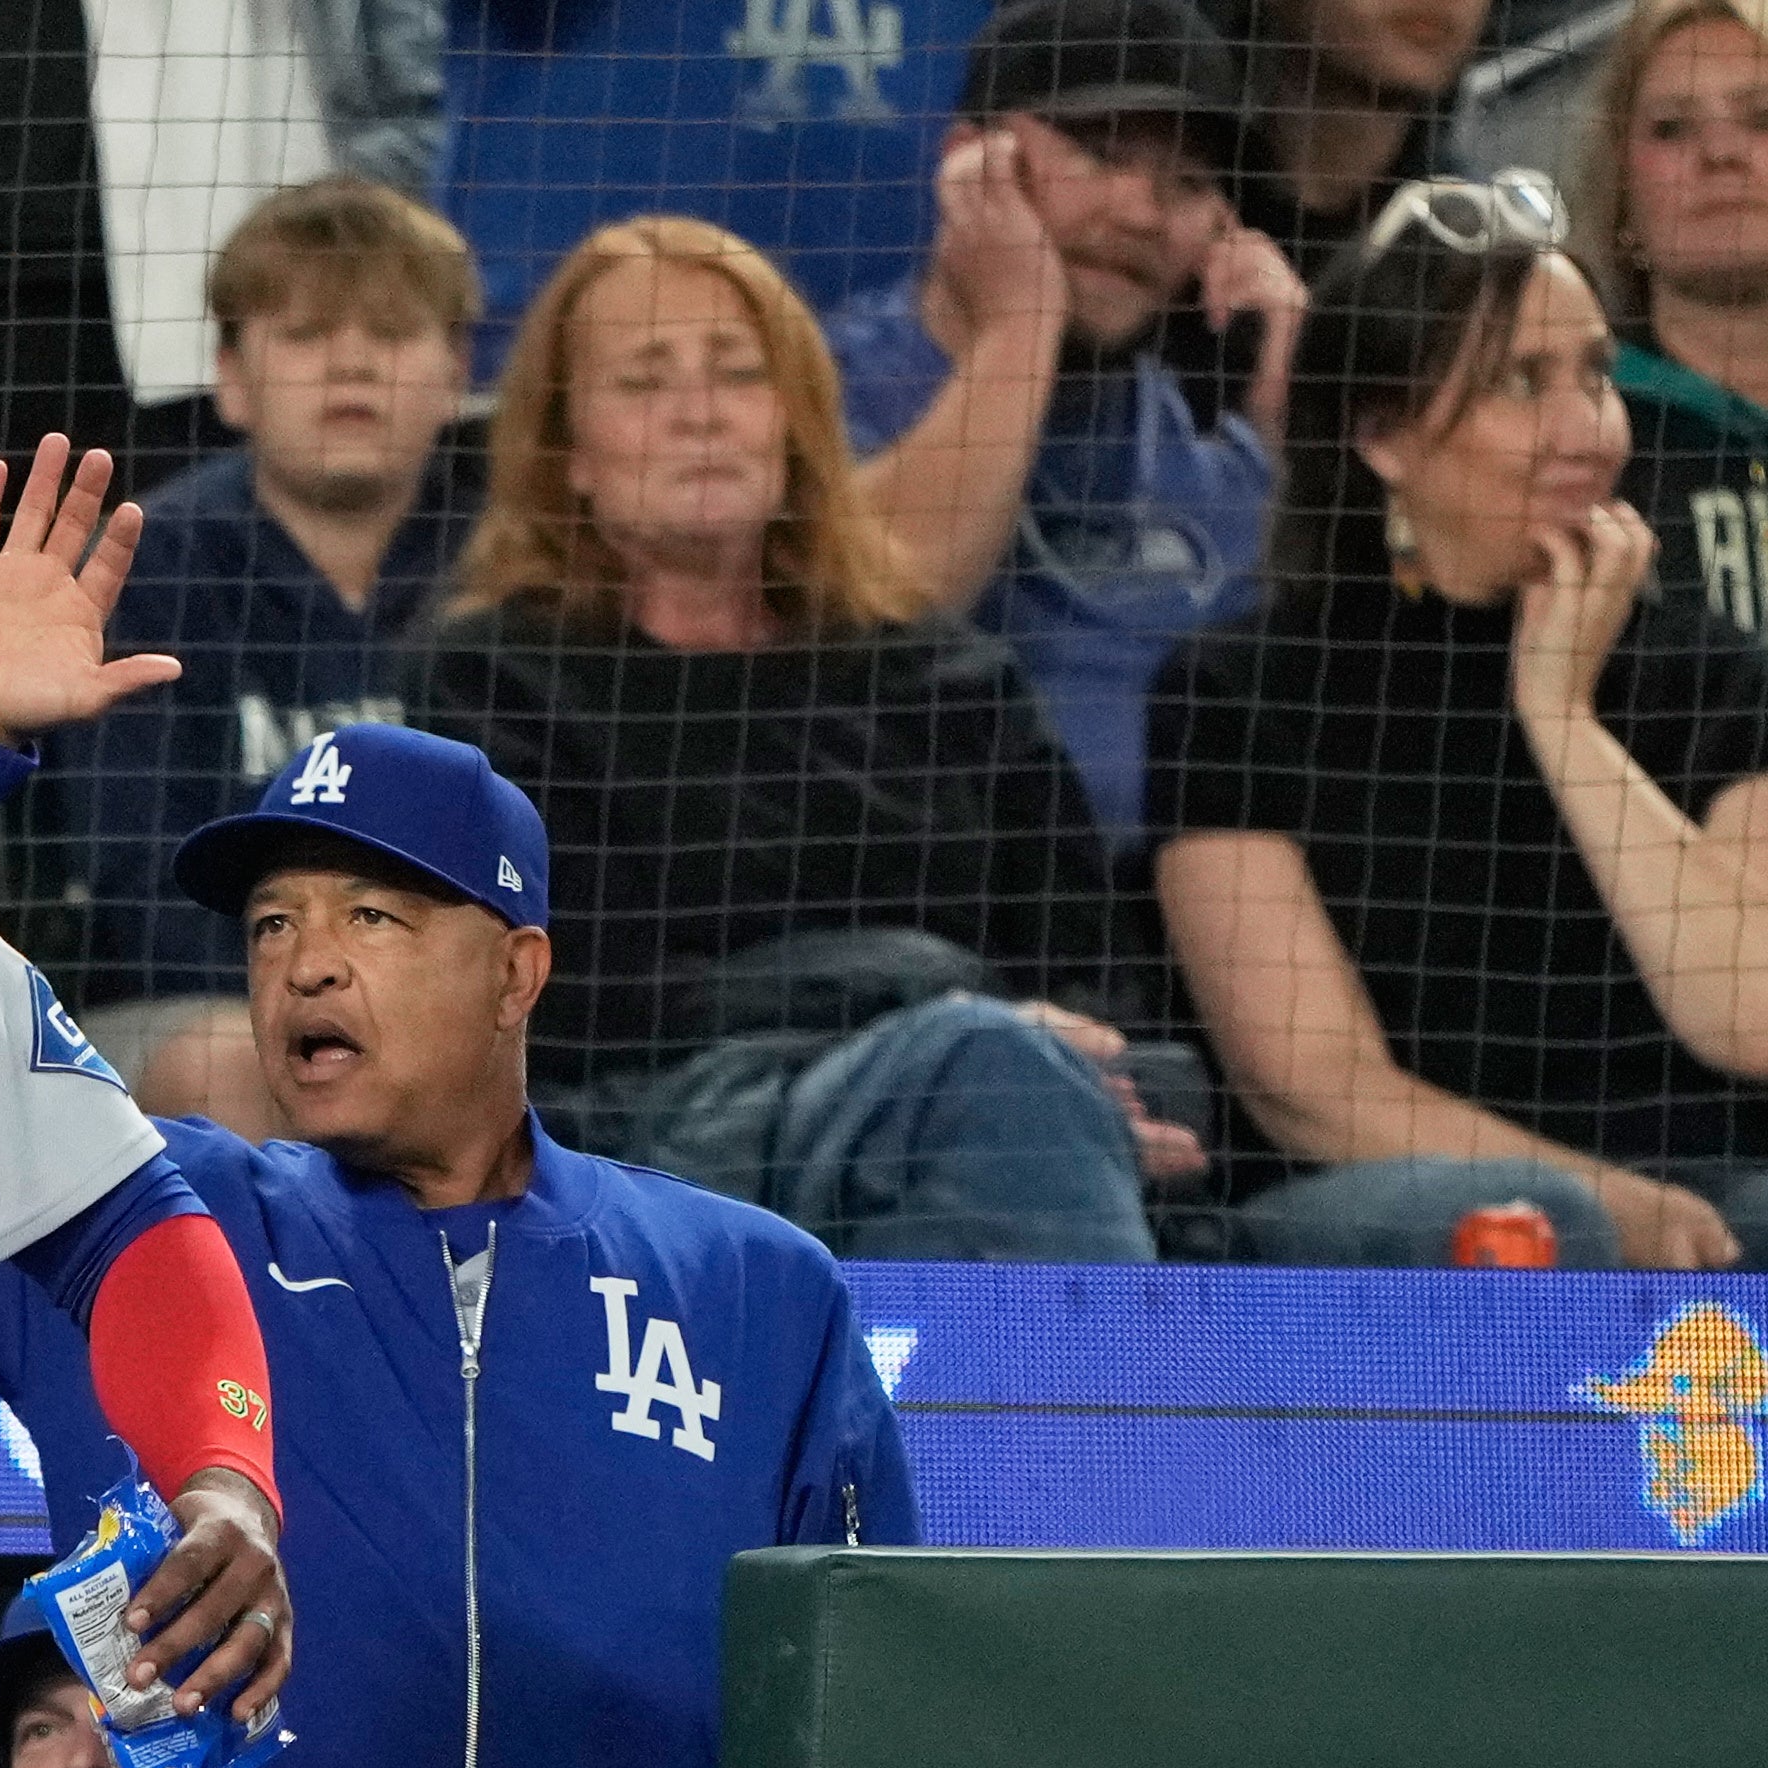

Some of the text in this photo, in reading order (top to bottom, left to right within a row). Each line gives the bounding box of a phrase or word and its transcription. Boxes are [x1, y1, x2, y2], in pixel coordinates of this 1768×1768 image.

[290, 731, 353, 805] LA
[216, 1378, 268, 1432] 37
[588, 1275, 723, 1462] LA
